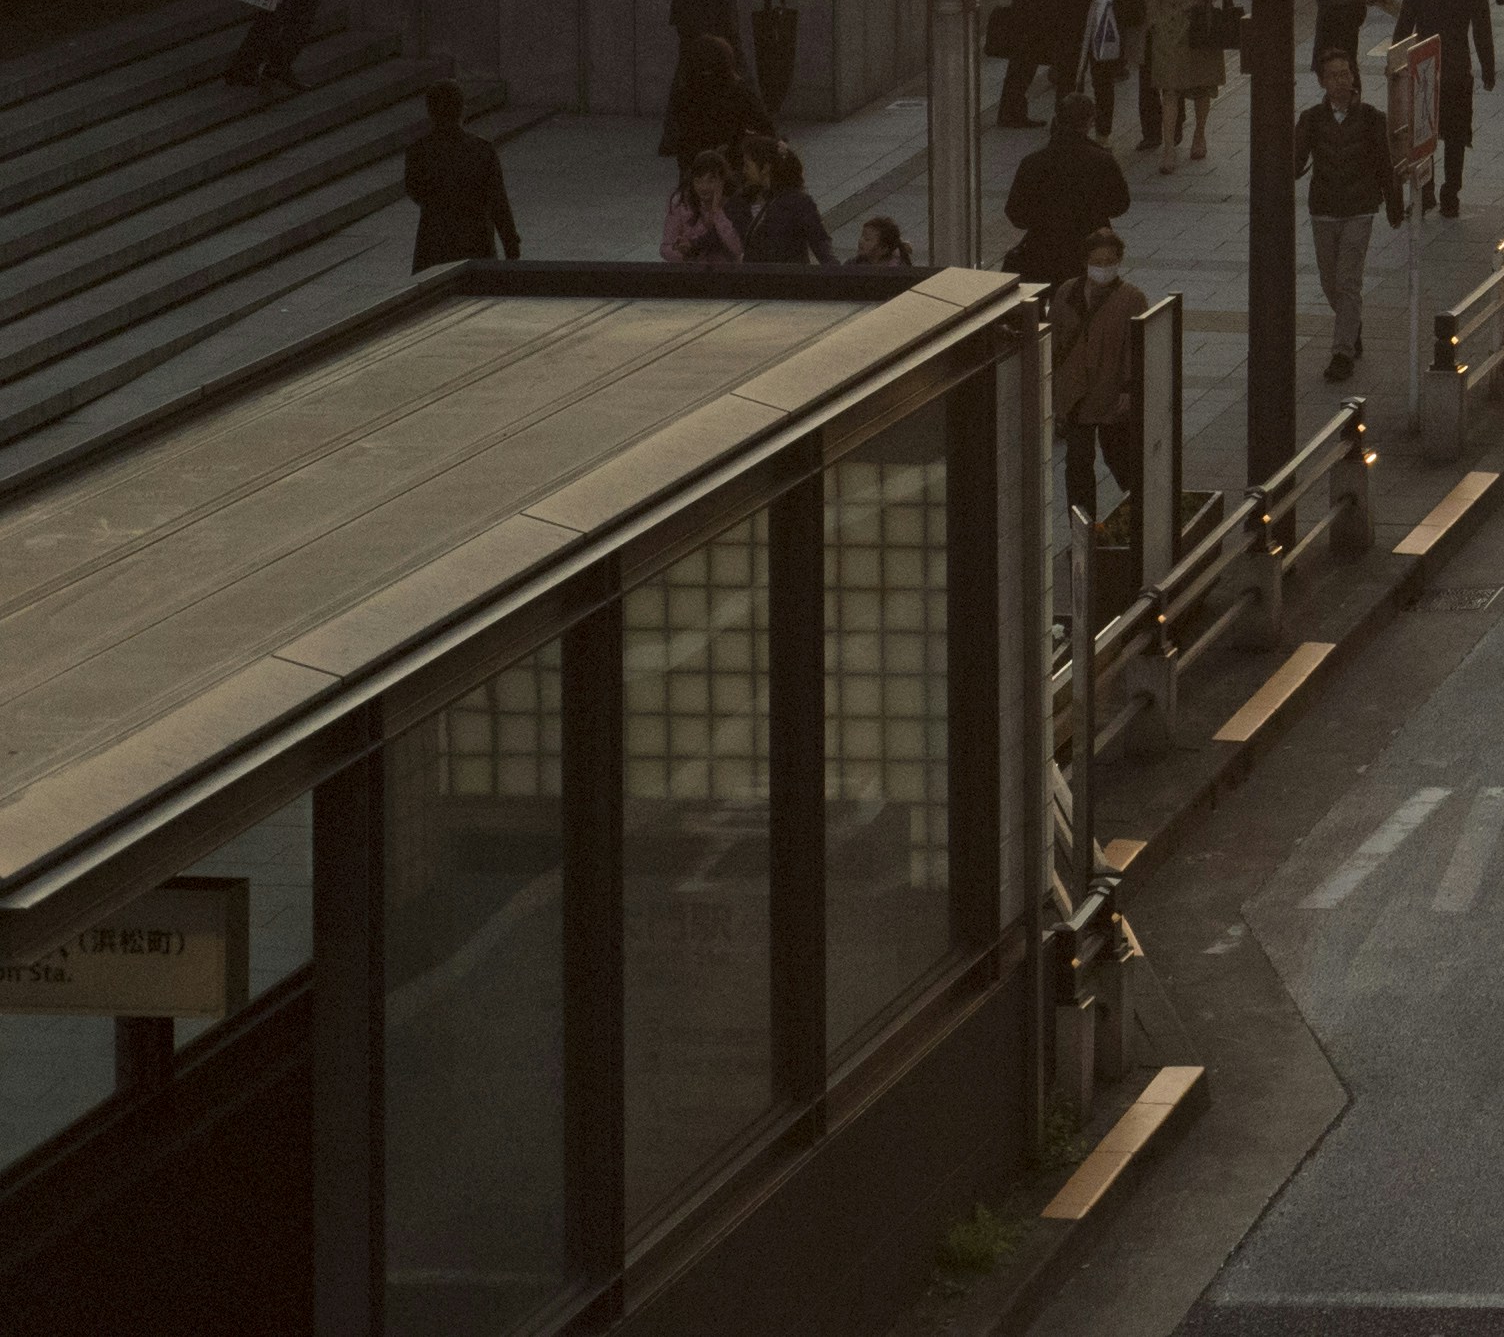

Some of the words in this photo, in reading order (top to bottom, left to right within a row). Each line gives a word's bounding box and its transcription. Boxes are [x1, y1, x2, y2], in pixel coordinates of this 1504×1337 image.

[79, 927, 185, 955] (浜松町)
[28, 964, 72, 983] Sta.
